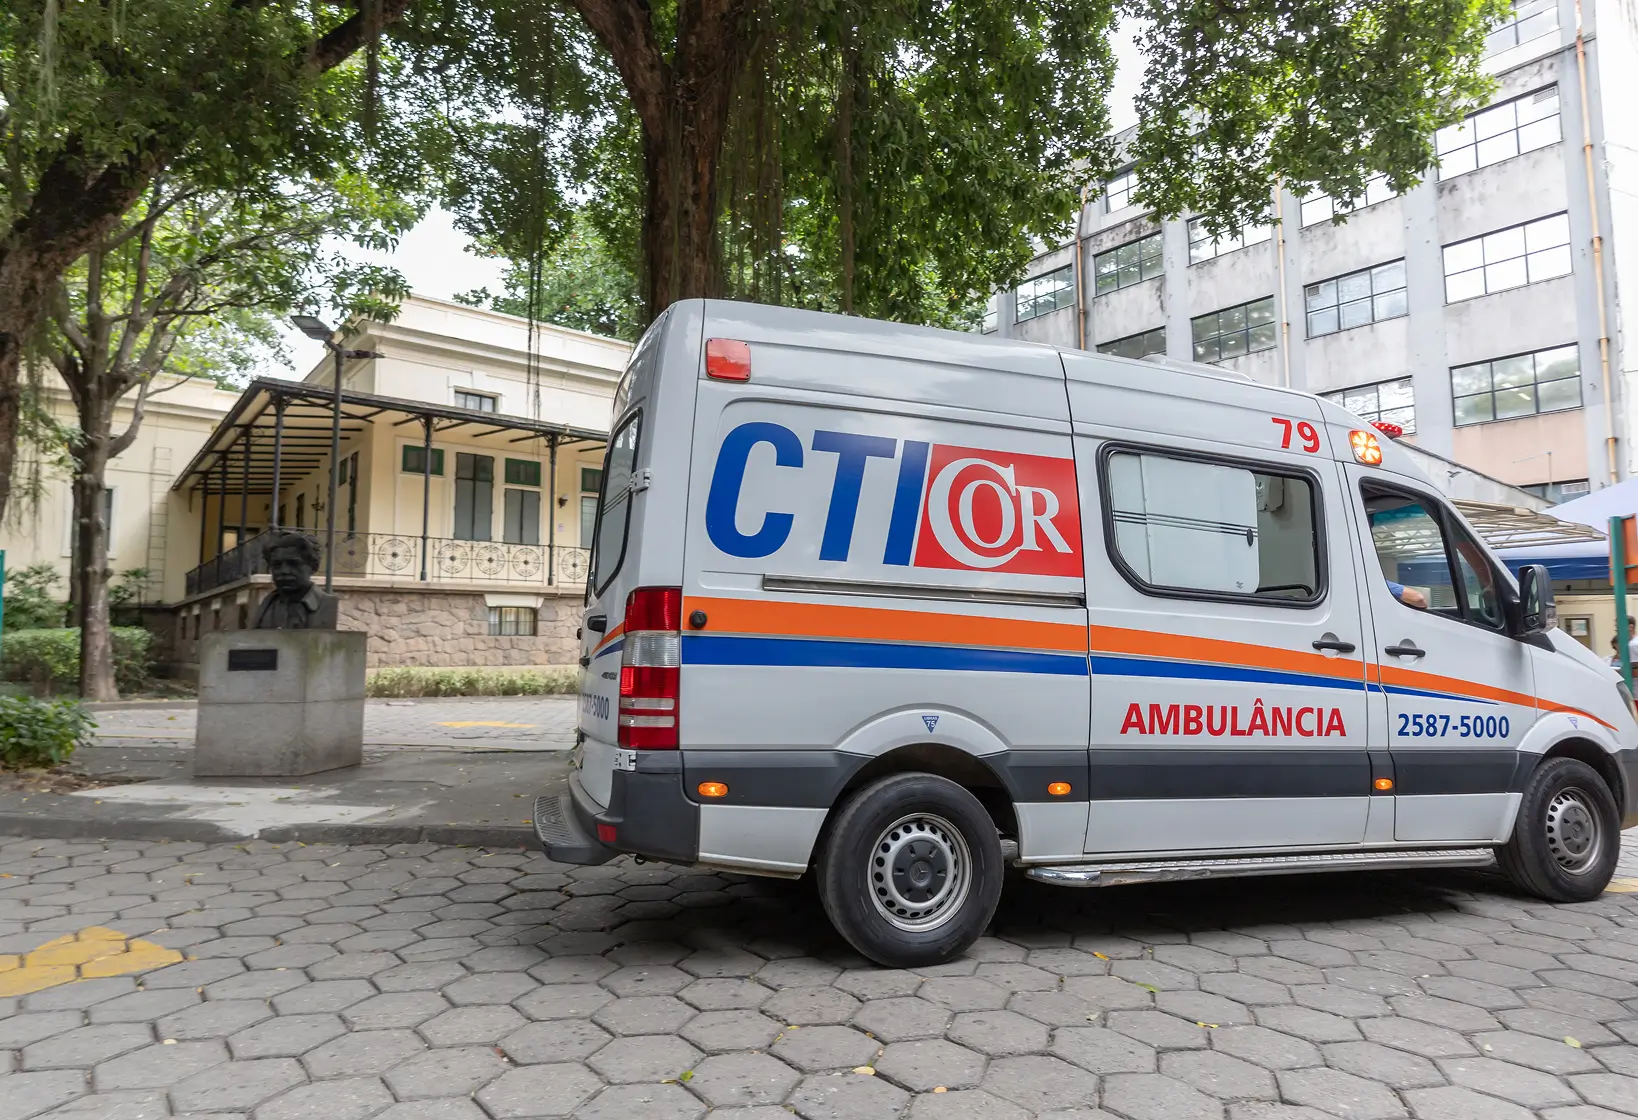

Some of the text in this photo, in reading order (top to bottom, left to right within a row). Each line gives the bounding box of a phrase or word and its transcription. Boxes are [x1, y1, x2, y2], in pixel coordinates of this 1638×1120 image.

[1271, 417, 1320, 453] 79
[705, 422, 1073, 569] CTI COR
[1120, 698, 1347, 737] AMBULÂNCIA
[1397, 713, 1510, 738] 2587-5000
